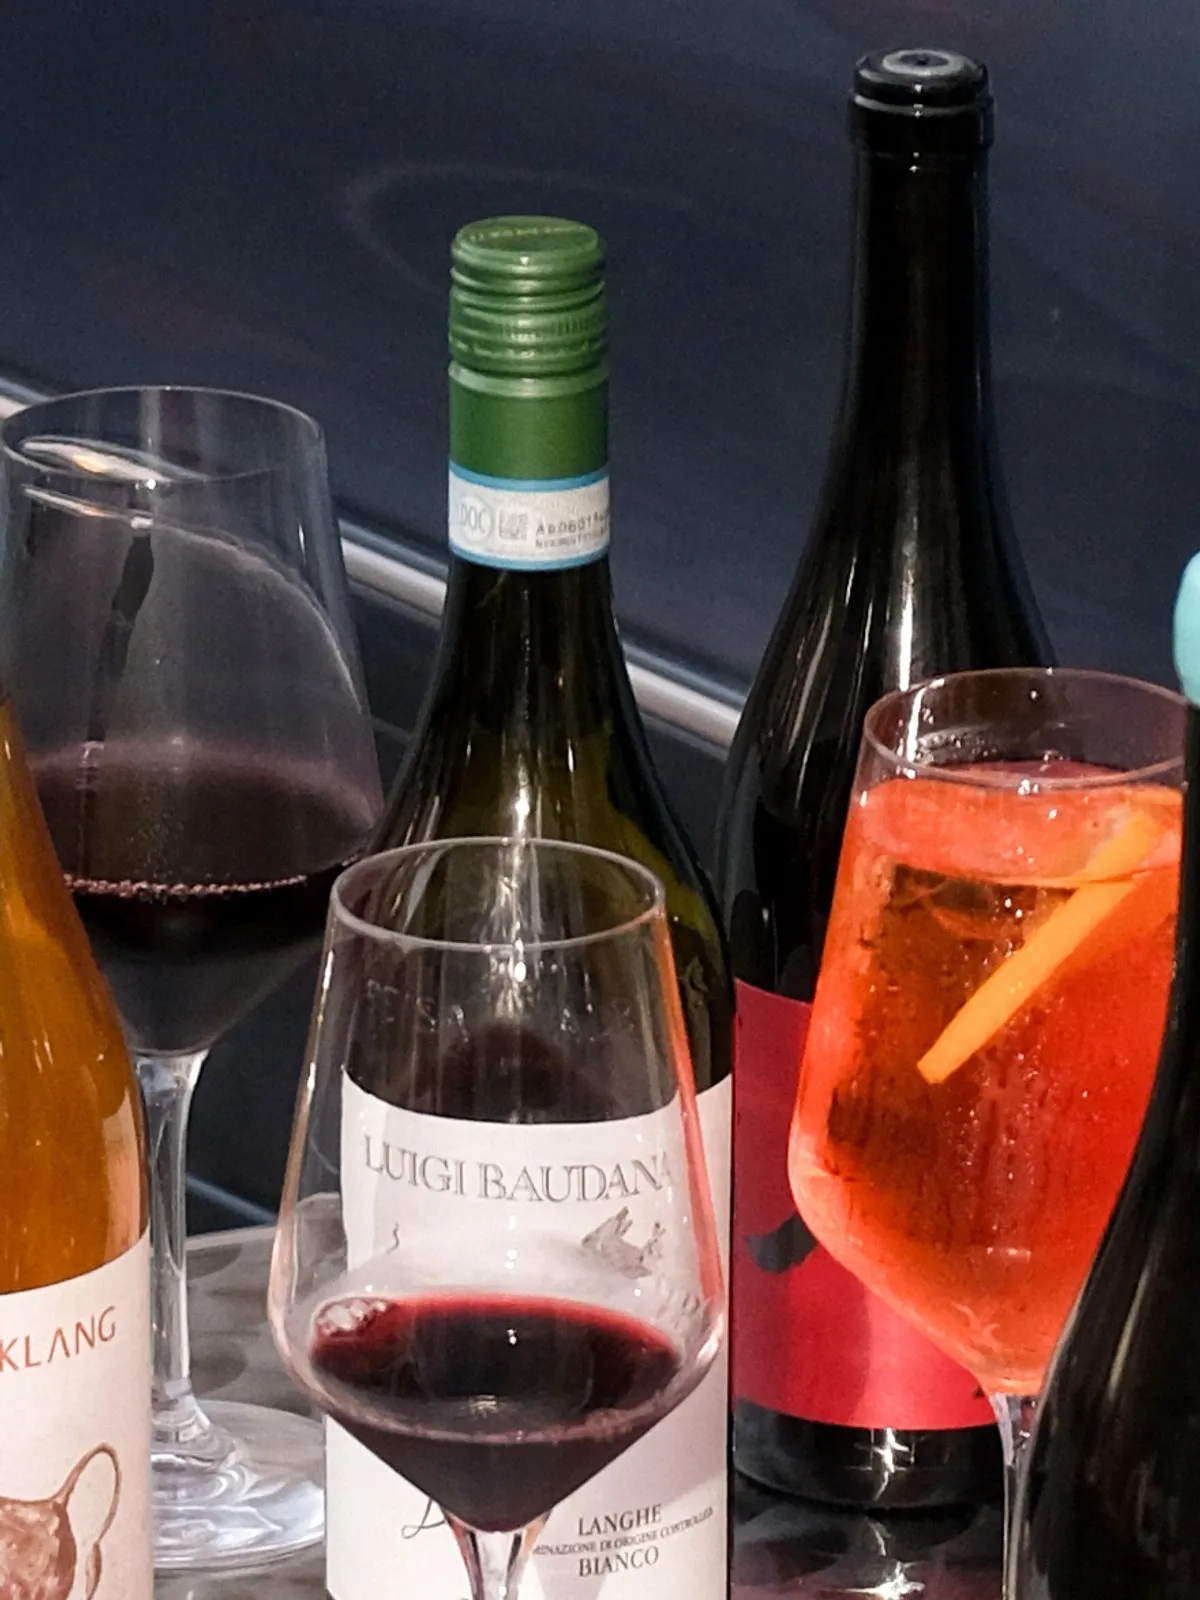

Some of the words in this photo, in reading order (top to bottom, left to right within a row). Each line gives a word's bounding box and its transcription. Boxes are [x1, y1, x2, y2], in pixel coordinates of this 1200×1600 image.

[364, 1134, 466, 1196] LUIGI
[0, 1305, 116, 1373] KLANG
[577, 1503, 663, 1537] LANGHE
[578, 1545, 660, 1577] BIANCO
